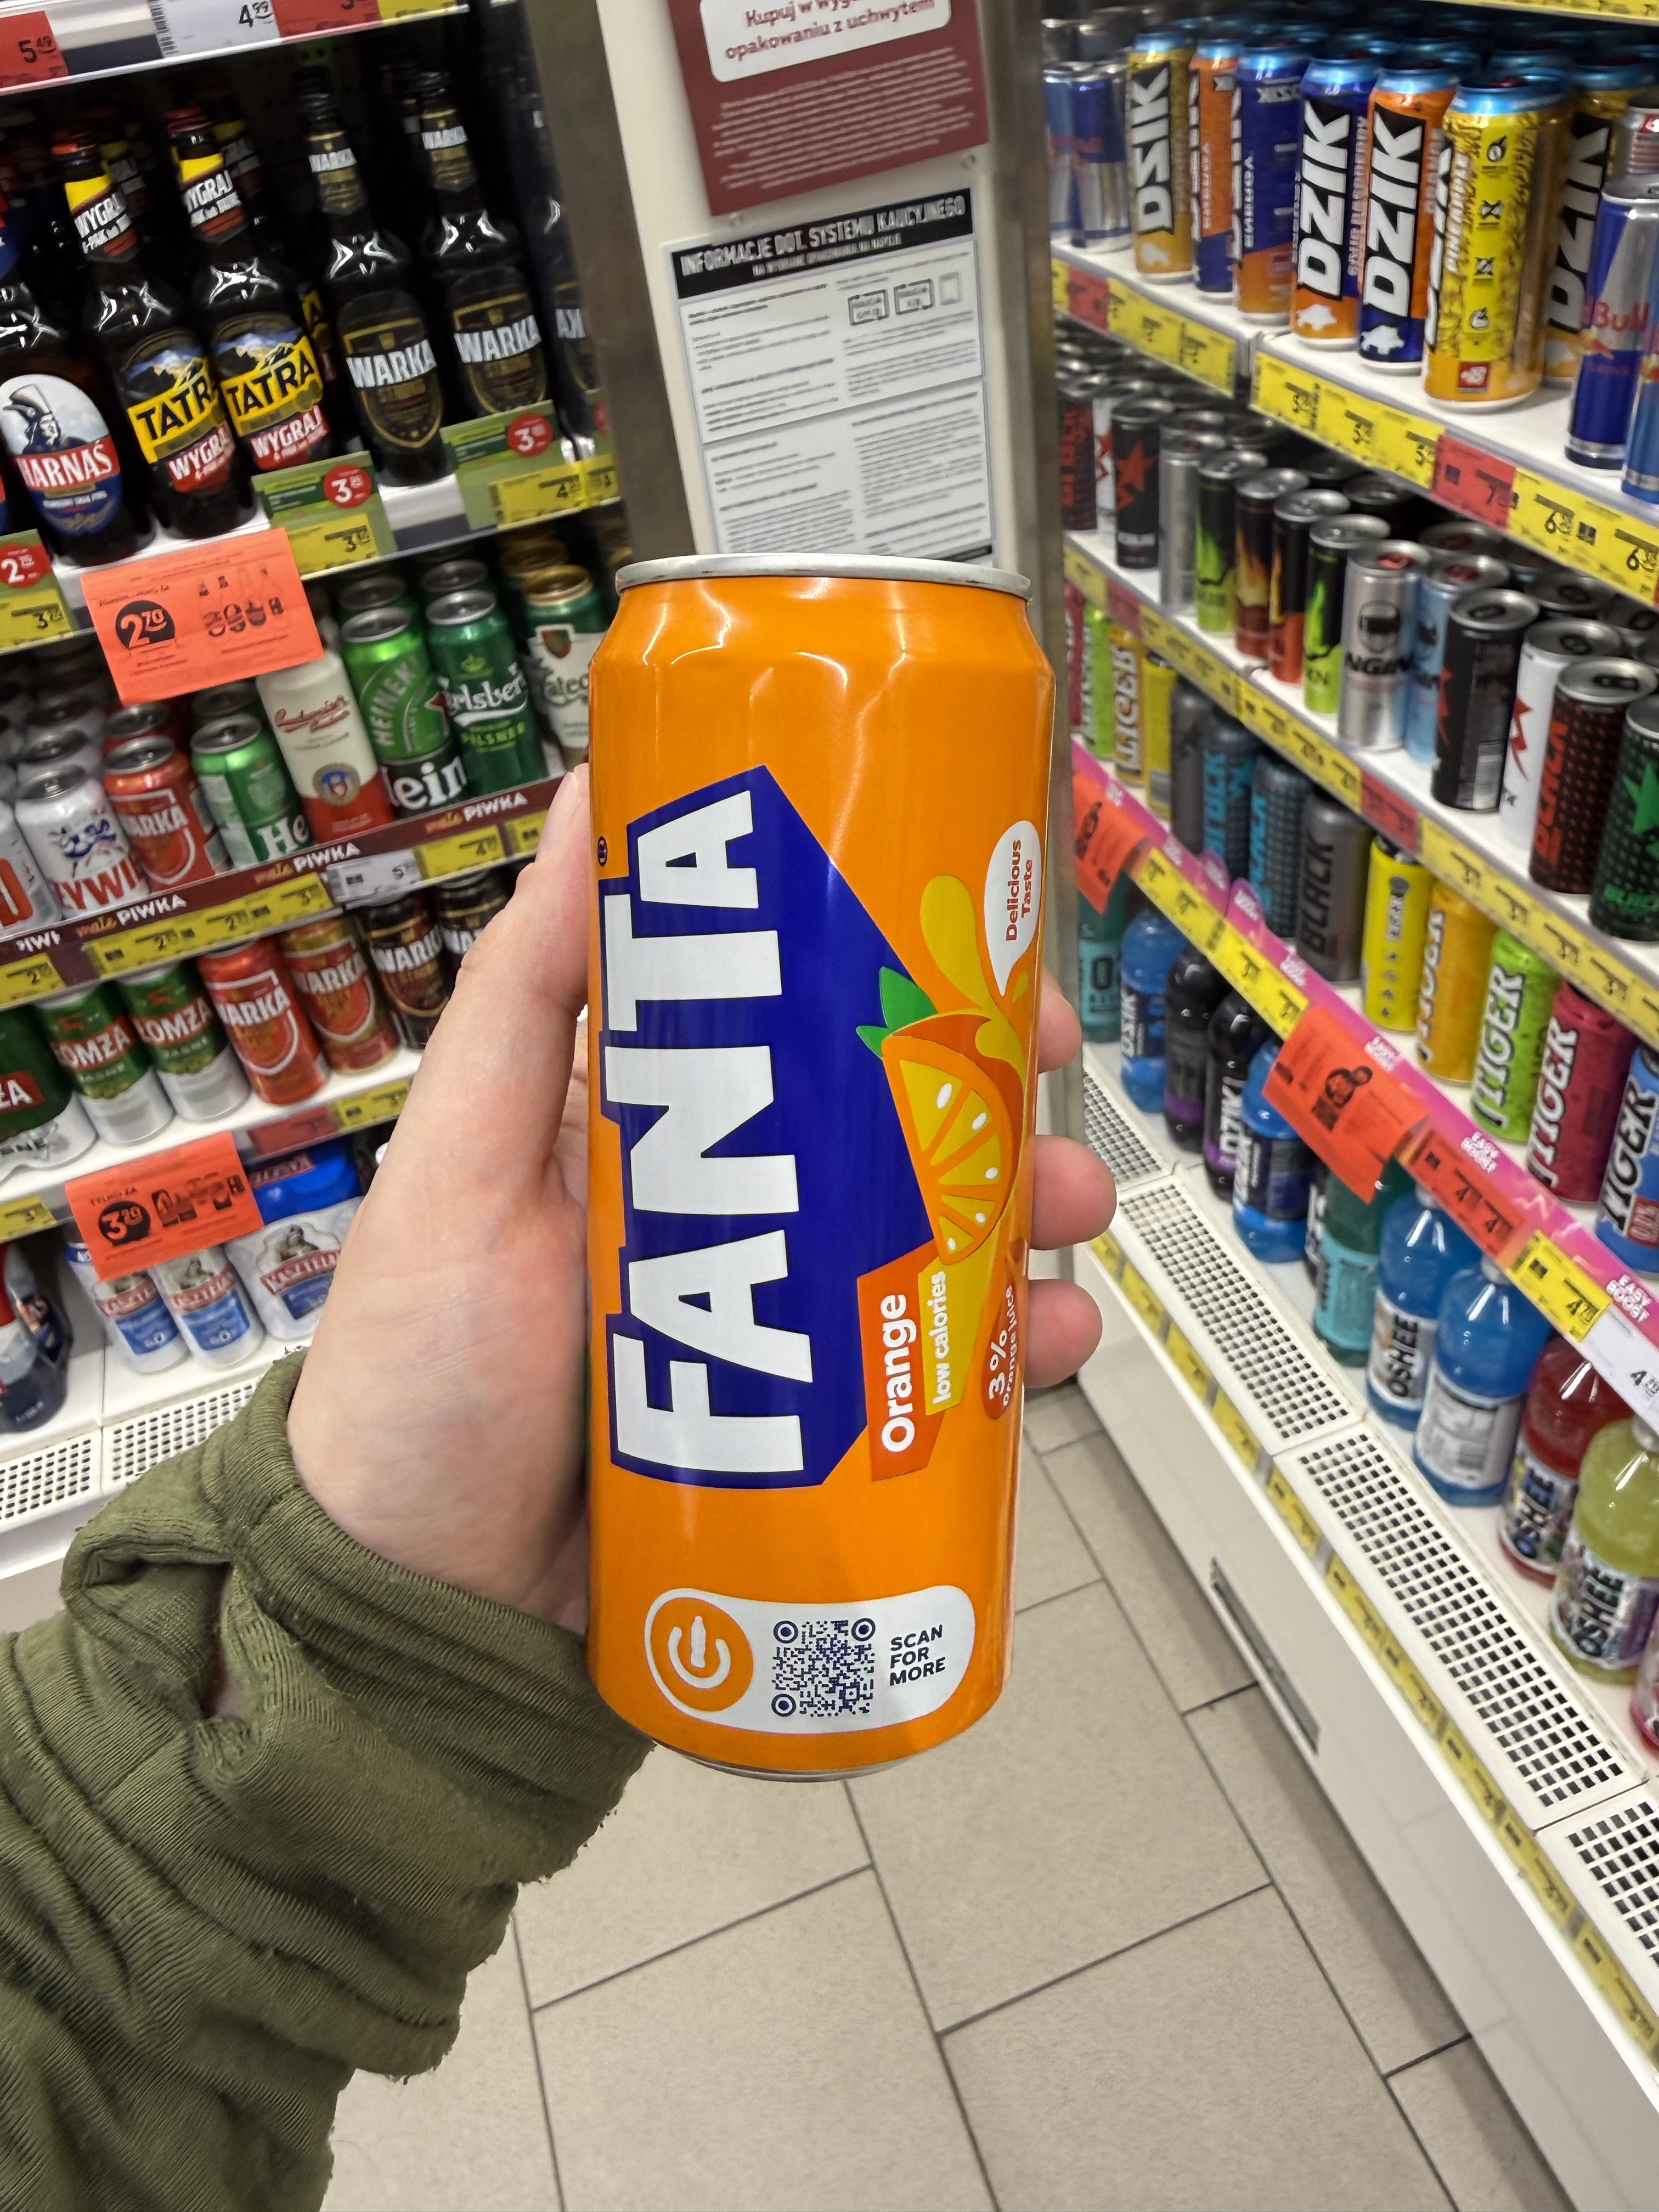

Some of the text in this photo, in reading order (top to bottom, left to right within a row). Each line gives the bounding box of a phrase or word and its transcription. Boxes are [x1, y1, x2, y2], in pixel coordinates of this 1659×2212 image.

[746, 2, 796, 27] Kupuj
[833, 20, 844, 33] z
[1298, 102, 1350, 299] DZIK
[1362, 111, 1423, 317] DZIK
[227, 360, 314, 415] TATRA
[346, 340, 437, 388] WARKA
[136, 377, 214, 440] TATR
[250, 405, 323, 457] WYGRAJ
[462, 792, 528, 821] PIWKA
[292, 842, 361, 872] PIWKA
[1021, 859, 1033, 918] Taste
[116, 894, 188, 926] PIWKA
[1006, 840, 1022, 941] Delicious
[1301, 830, 1334, 955] BLACK
[1476, 964, 1526, 1128] TIGER
[605, 791, 813, 1472] FANTA
[1527, 1016, 1578, 1188] TIGER
[1599, 1075, 1657, 1236] TIGER
[1619, 1274, 1652, 1306] EASY
[927, 1271, 952, 1404] low calories
[1389, 1316, 1419, 1397] OSHEE
[880, 1294, 917, 1452] Orange
[1513, 1468, 1555, 1559] OSHEE
[890, 1624, 944, 1652] SCAN
[1577, 1566, 1624, 1657] OSHEE
[889, 1647, 930, 1669] FOR
[889, 1657, 946, 1687] MORE
